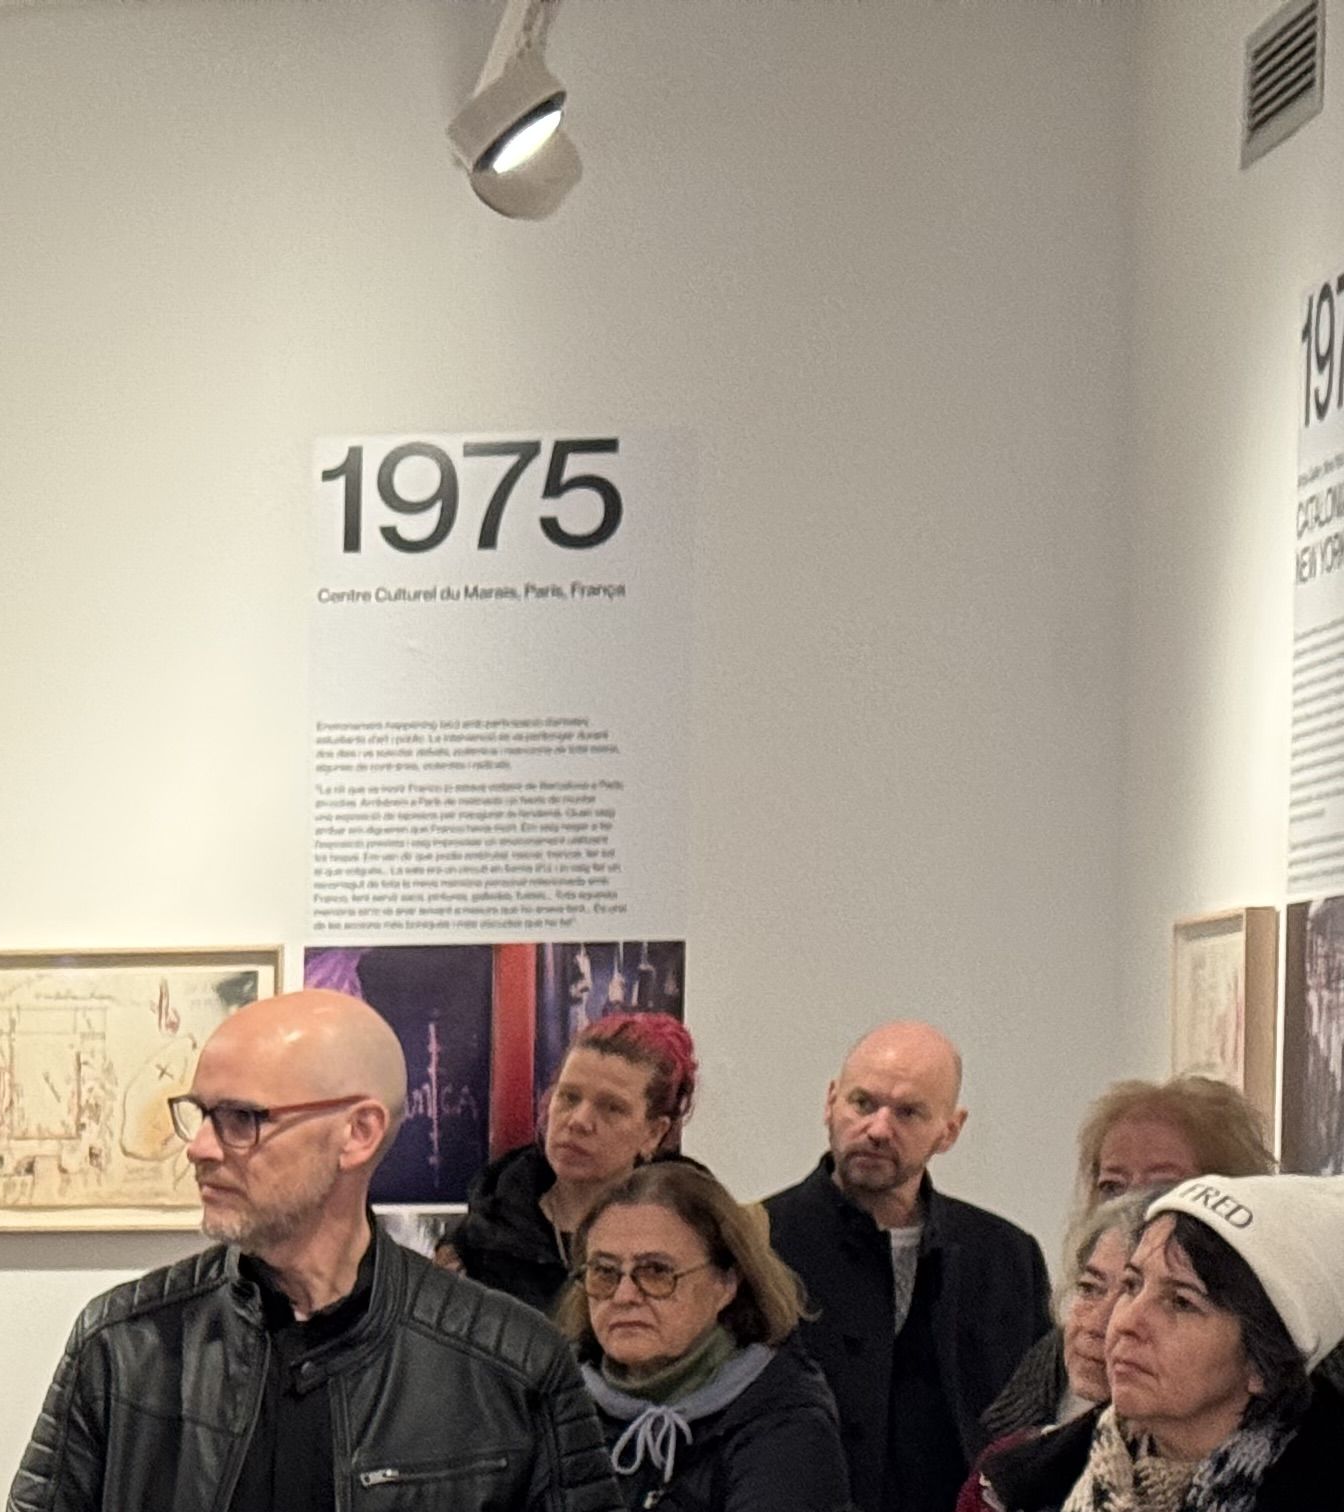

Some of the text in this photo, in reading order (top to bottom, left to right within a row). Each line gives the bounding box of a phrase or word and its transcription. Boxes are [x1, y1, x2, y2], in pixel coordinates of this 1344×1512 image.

[321, 438, 624, 554] 1975
[317, 587, 372, 603] Centre
[374, 585, 437, 602] Culturel
[440, 585, 460, 601] du
[1179, 1183, 1254, 1229] FRED
